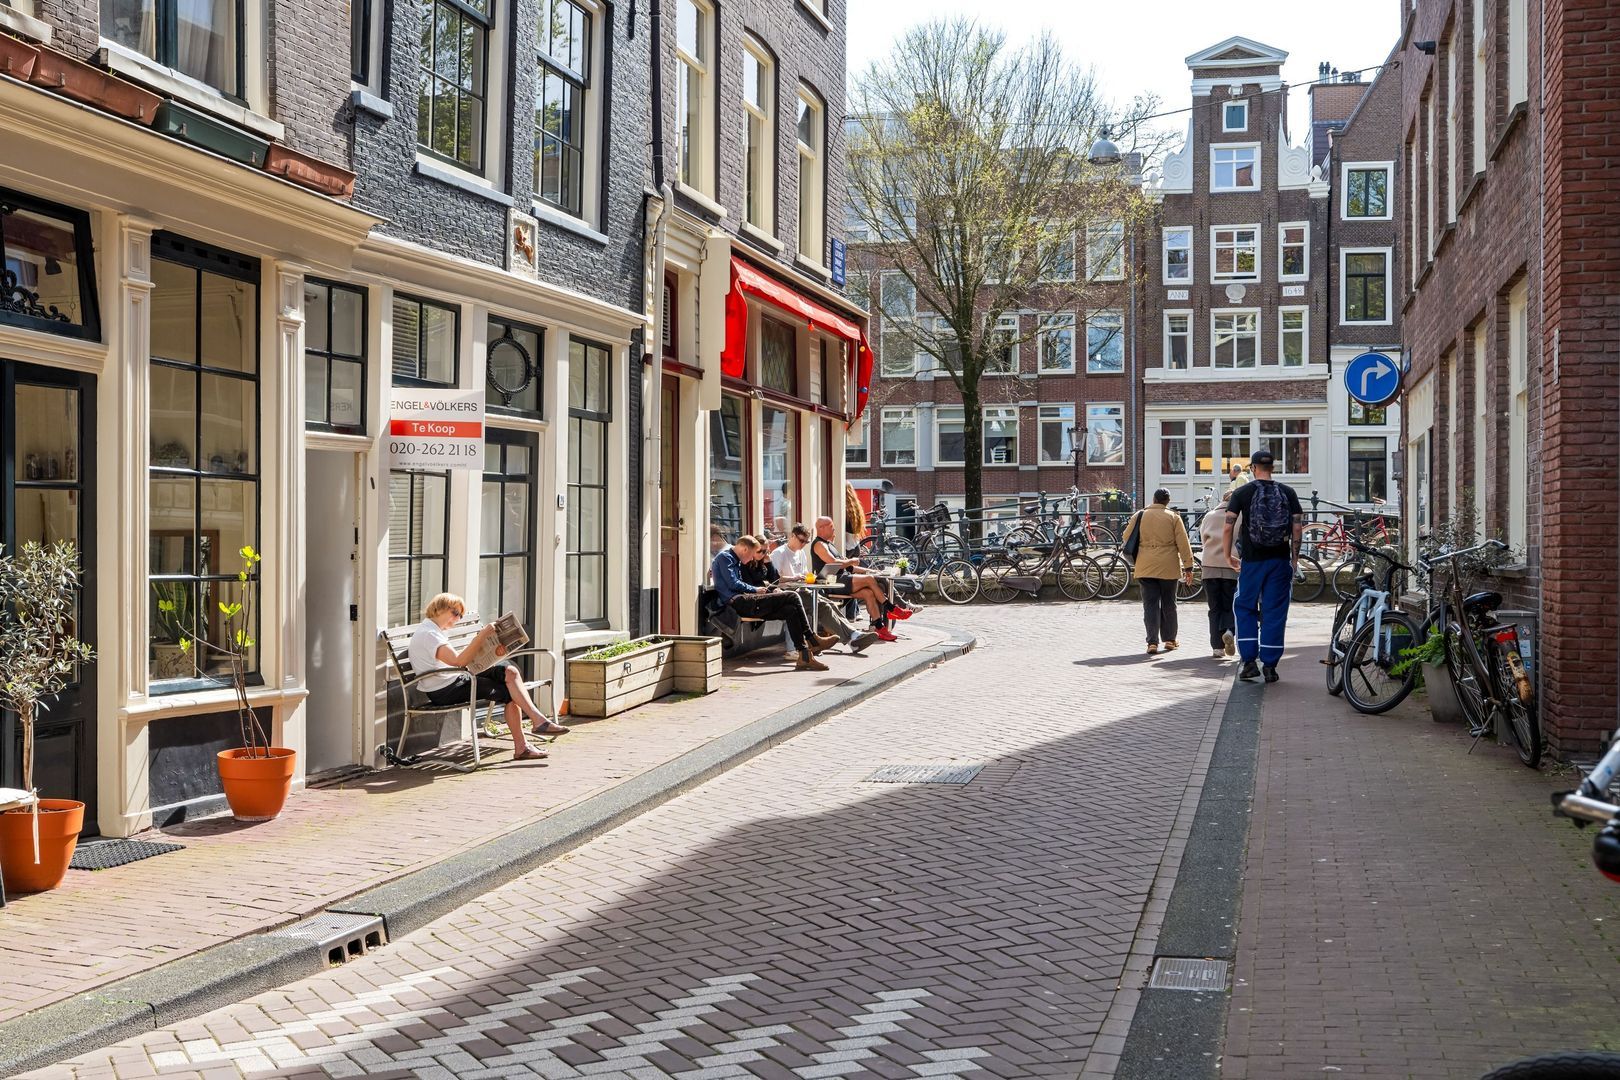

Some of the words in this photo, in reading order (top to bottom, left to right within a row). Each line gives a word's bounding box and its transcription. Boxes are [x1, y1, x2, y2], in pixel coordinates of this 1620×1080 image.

[1169, 291, 1187, 299] ANNO
[391, 400, 478, 412] ENGEL&VÖLKERS
[412, 423, 426, 433] Te
[428, 424, 456, 436] Koop
[390, 442, 445, 455] 020-262
[448, 443, 460, 456] 21
[464, 444, 477, 457] 18
